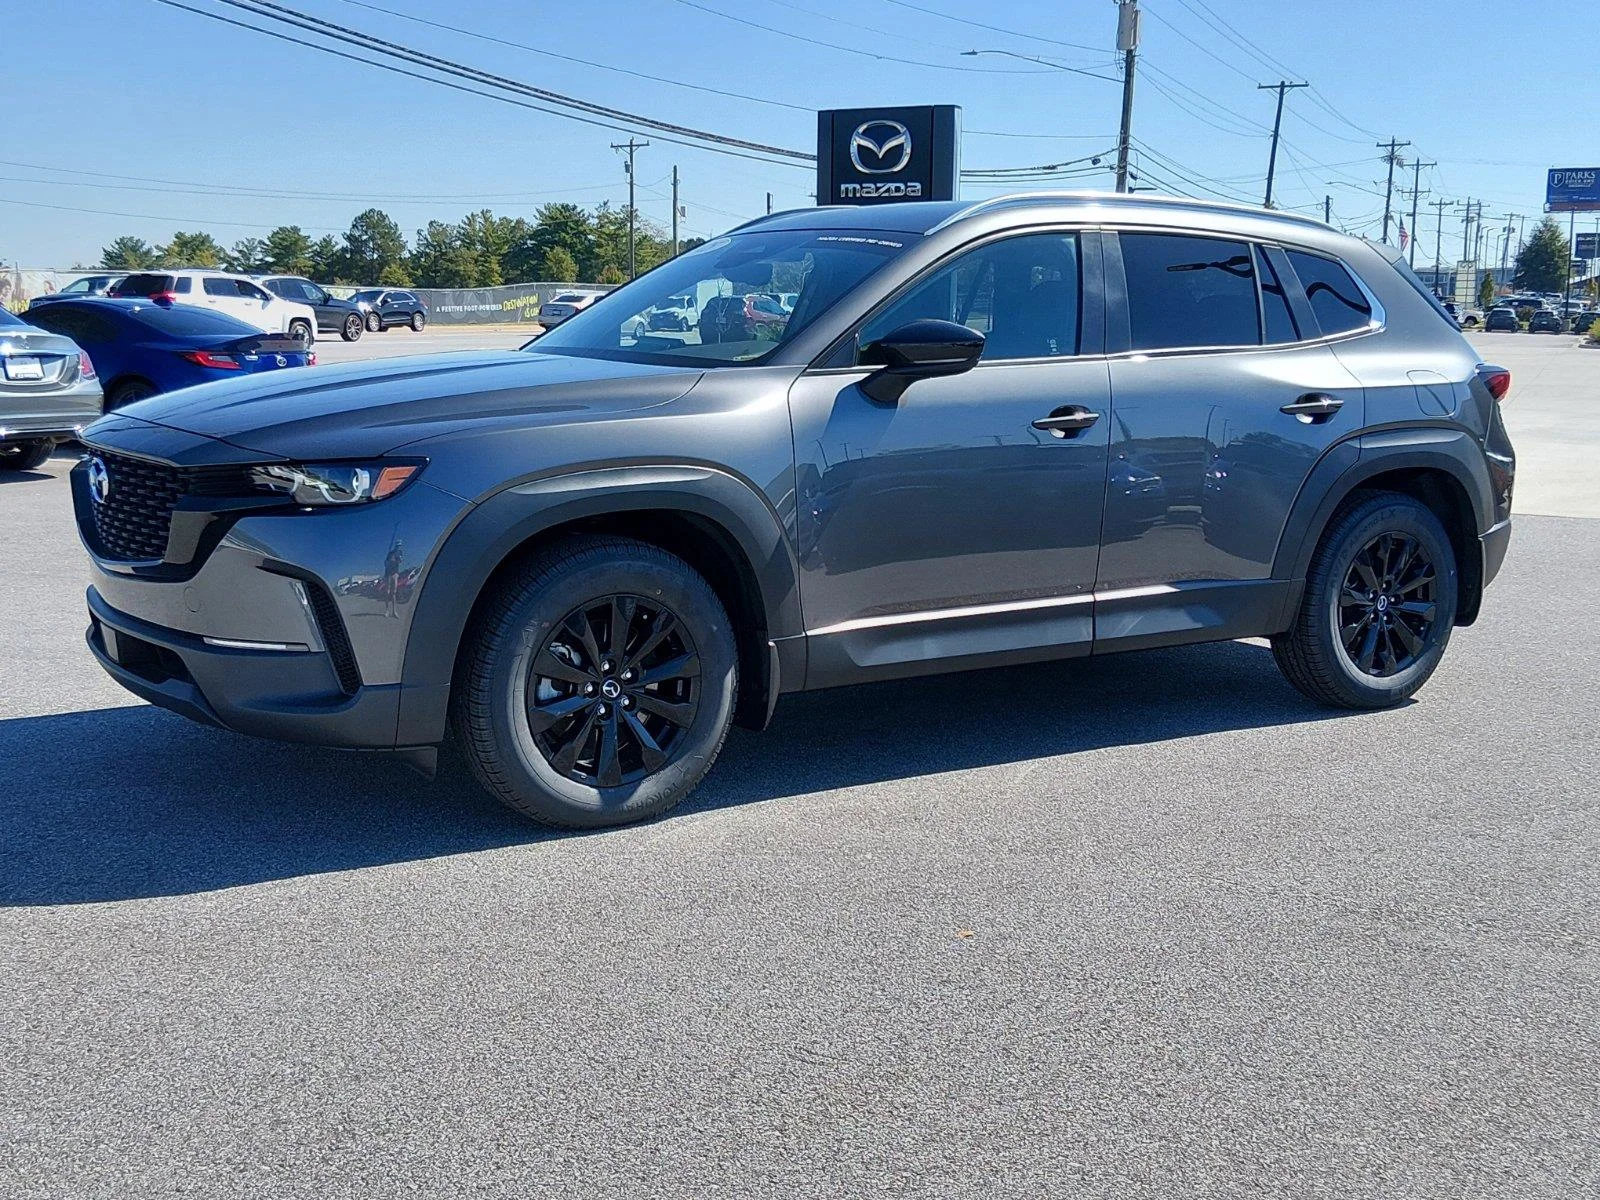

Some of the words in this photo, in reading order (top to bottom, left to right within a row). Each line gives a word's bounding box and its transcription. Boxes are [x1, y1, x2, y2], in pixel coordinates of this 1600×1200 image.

[1566, 171, 1595, 180] PARKS
[503, 293, 539, 312] DESTINATION
[441, 305, 463, 313] FESTIVE
